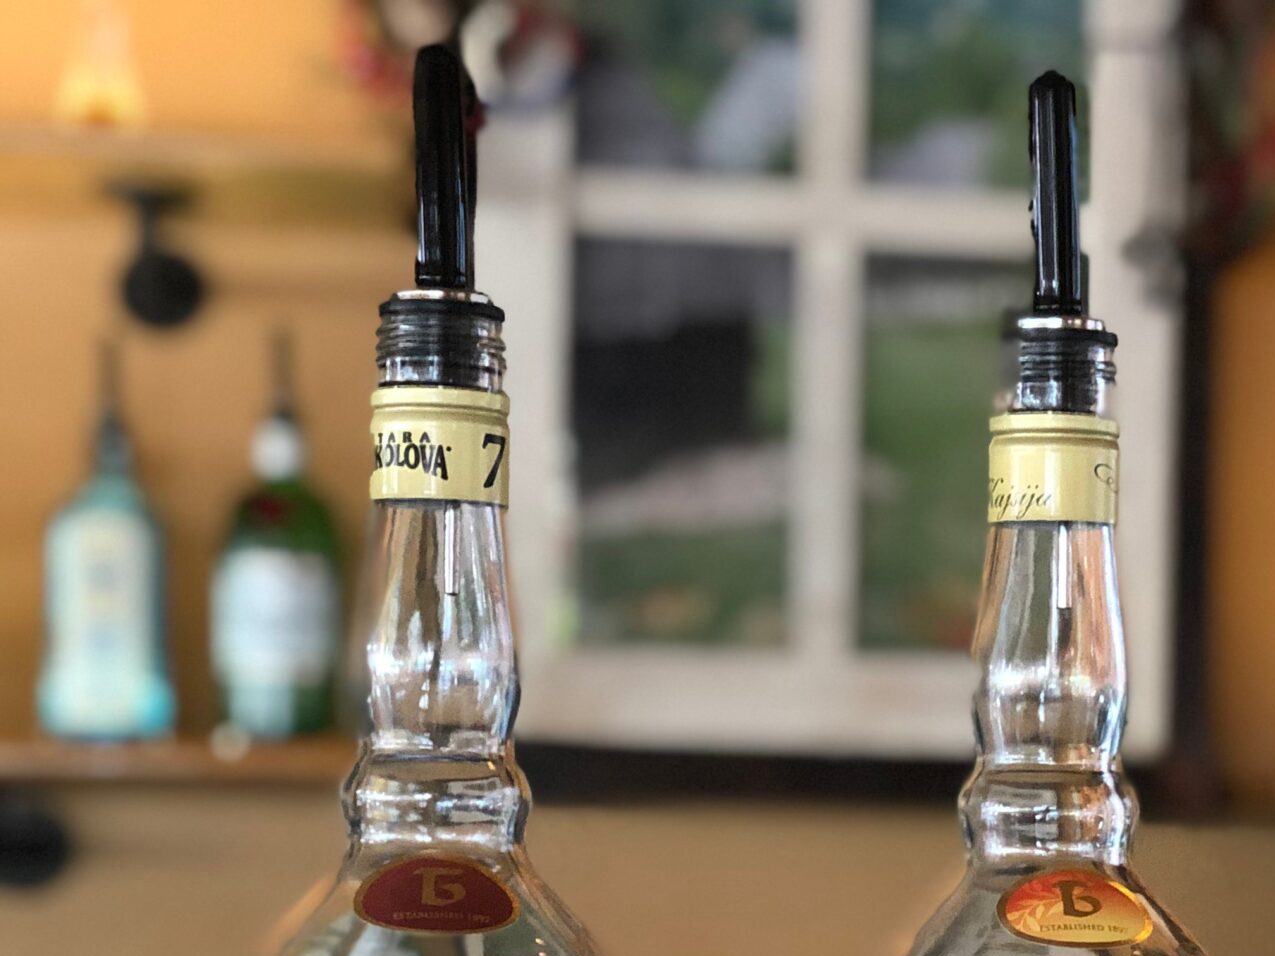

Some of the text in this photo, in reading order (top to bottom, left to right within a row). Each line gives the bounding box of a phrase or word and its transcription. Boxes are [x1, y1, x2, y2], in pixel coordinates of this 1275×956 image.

[377, 431, 431, 443] TARA
[482, 433, 506, 488] 7
[1040, 923, 1104, 932] ESTABLISHED
